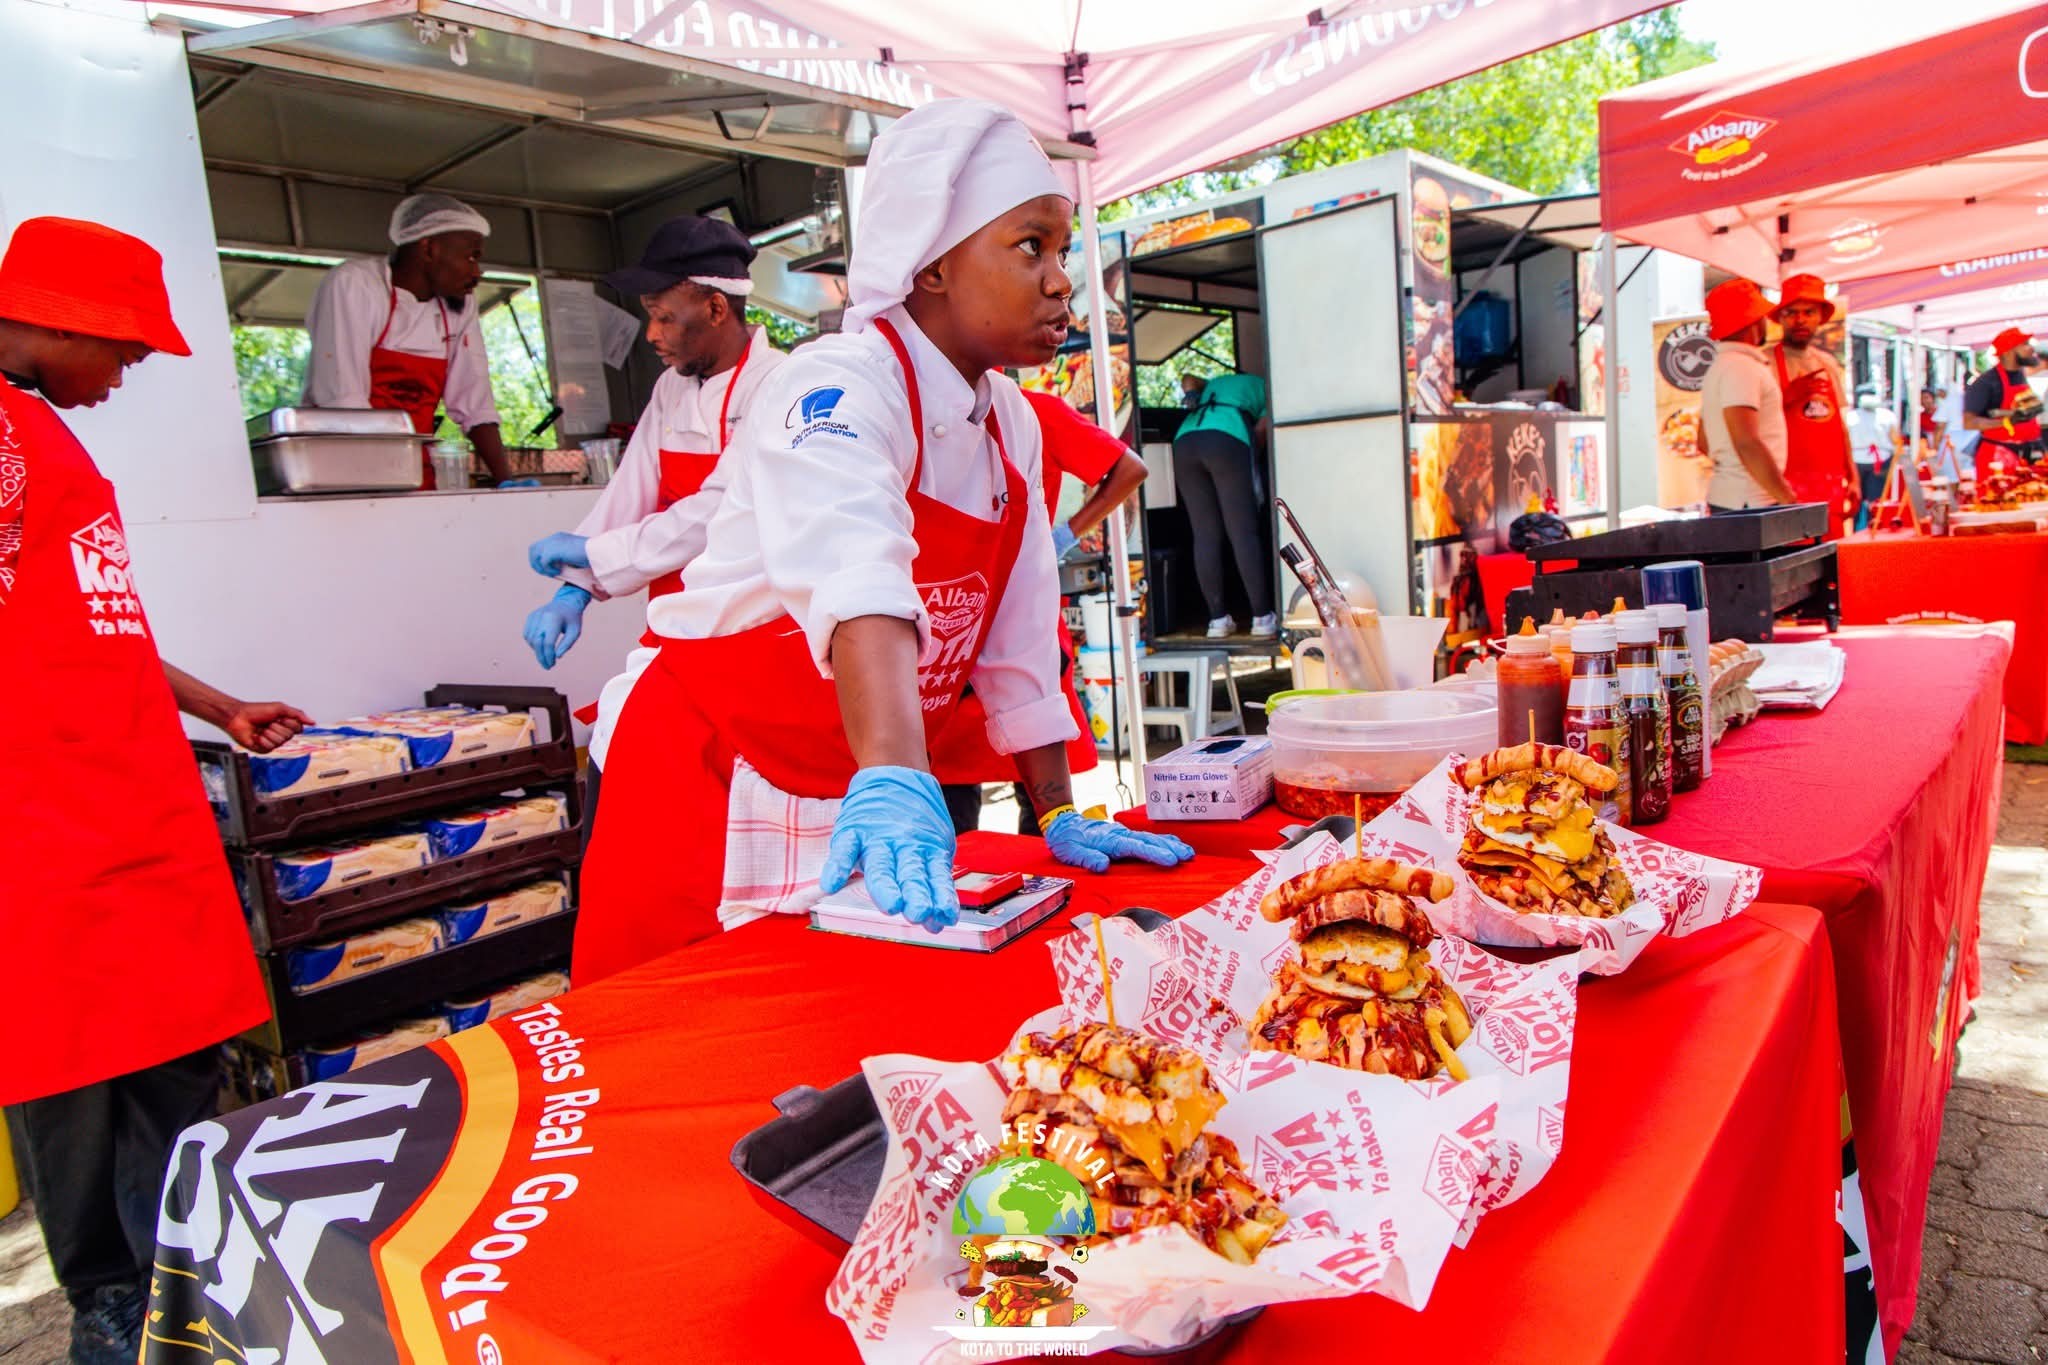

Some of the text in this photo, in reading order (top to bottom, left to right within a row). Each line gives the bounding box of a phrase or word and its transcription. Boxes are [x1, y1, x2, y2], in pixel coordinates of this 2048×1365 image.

[1687, 121, 1768, 152] Albany
[812, 421, 848, 430] AFRICAN
[89, 619, 116, 635] Ya
[1154, 771, 1228, 782] Nitrile Exam Gloves
[1194, 805, 1207, 814] ISO
[1235, 914, 1254, 932] Ya
[1056, 930, 1092, 991] OTA
[1180, 920, 1209, 981] OTA
[1083, 957, 1125, 1017] Makya
[1143, 983, 1203, 1047] KOT
[1494, 994, 1571, 1074] KOTA
[1485, 1014, 1521, 1064] Albany
[885, 1079, 928, 1110] any
[441, 1002, 600, 1331] Tastes Real Good!
[1438, 1144, 1467, 1206] Albany
[865, 1322, 887, 1341] Ya
